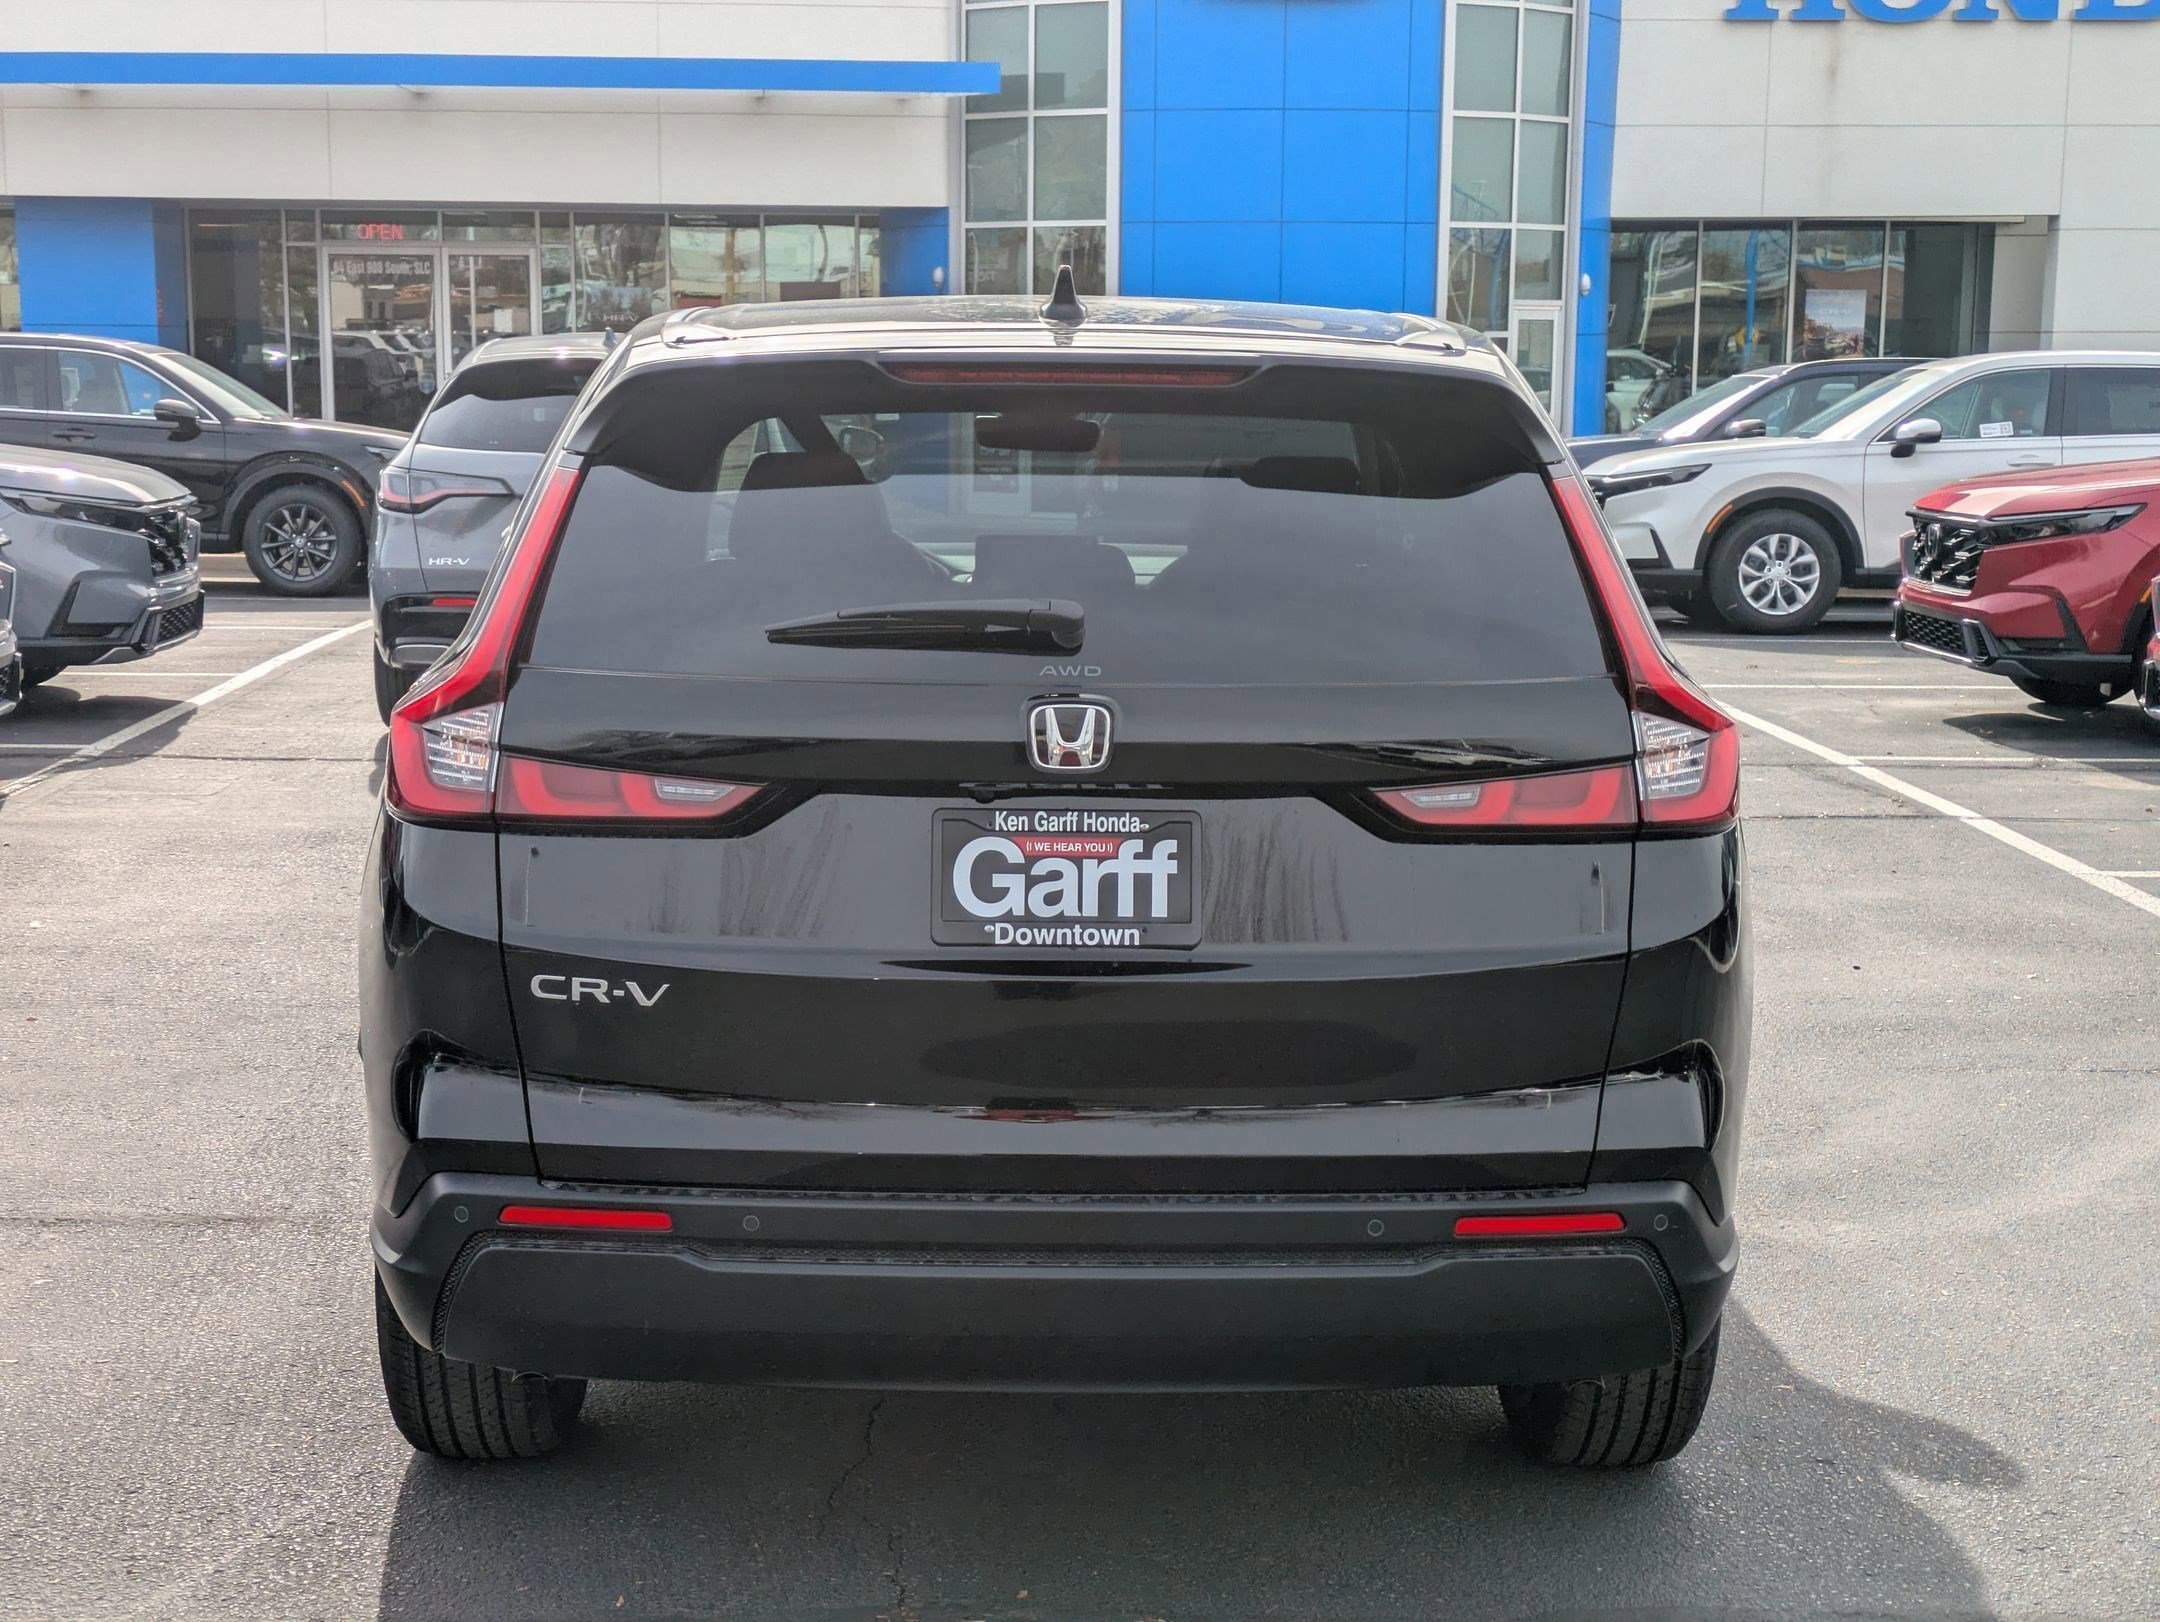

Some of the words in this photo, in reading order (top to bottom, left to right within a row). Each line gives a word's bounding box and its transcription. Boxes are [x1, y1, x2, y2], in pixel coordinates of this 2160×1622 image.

[356, 223, 404, 240] OPEN
[346, 260, 365, 274] East
[414, 260, 431, 274] SLC
[428, 557, 470, 566] HR-V
[1039, 665, 1102, 677] AWD
[994, 810, 1029, 832] Ken
[1034, 810, 1078, 832] Garff
[1083, 811, 1141, 833] Honda
[1034, 842, 1051, 852] WE
[1053, 842, 1082, 852] HEAR
[1084, 842, 1106, 853] YOU
[952, 836, 1178, 918] Garff
[994, 923, 1140, 946] Downtown
[530, 974, 671, 1007] CR-V
